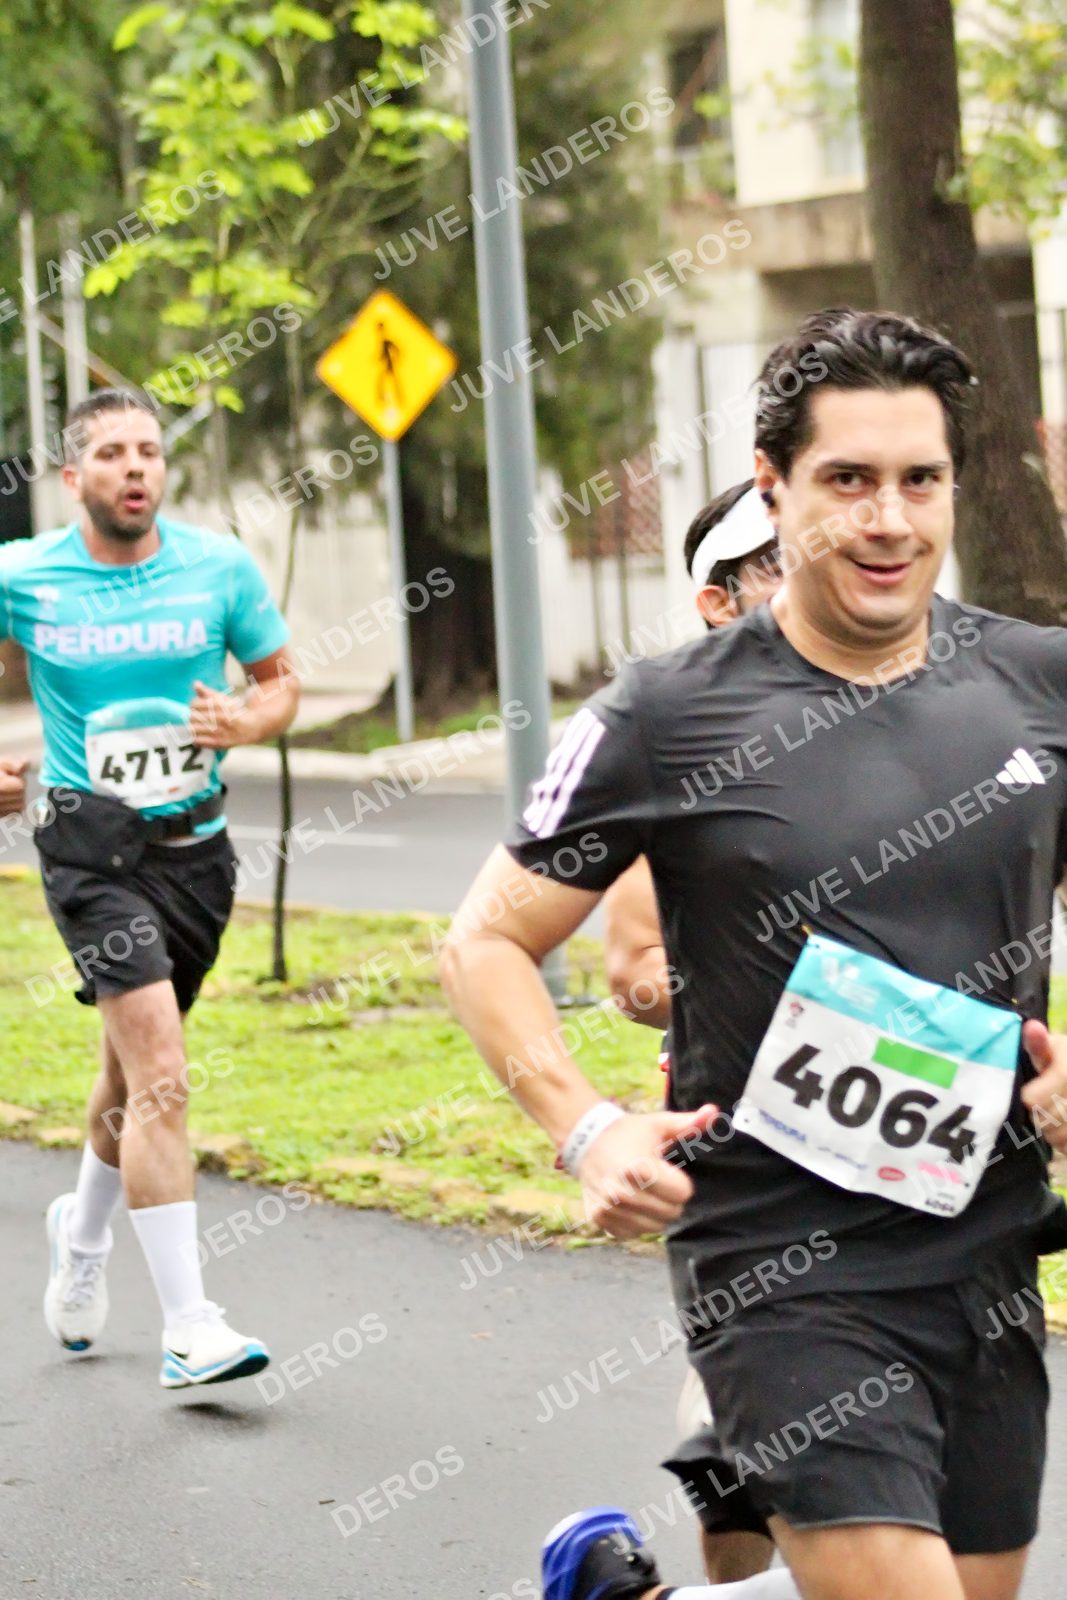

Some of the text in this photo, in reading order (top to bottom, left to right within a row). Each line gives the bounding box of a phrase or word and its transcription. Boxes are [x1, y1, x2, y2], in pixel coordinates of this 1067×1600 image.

[34, 616, 208, 655] PERDURA
[101, 743, 203, 784] 4712
[773, 1043, 976, 1165] 4064
